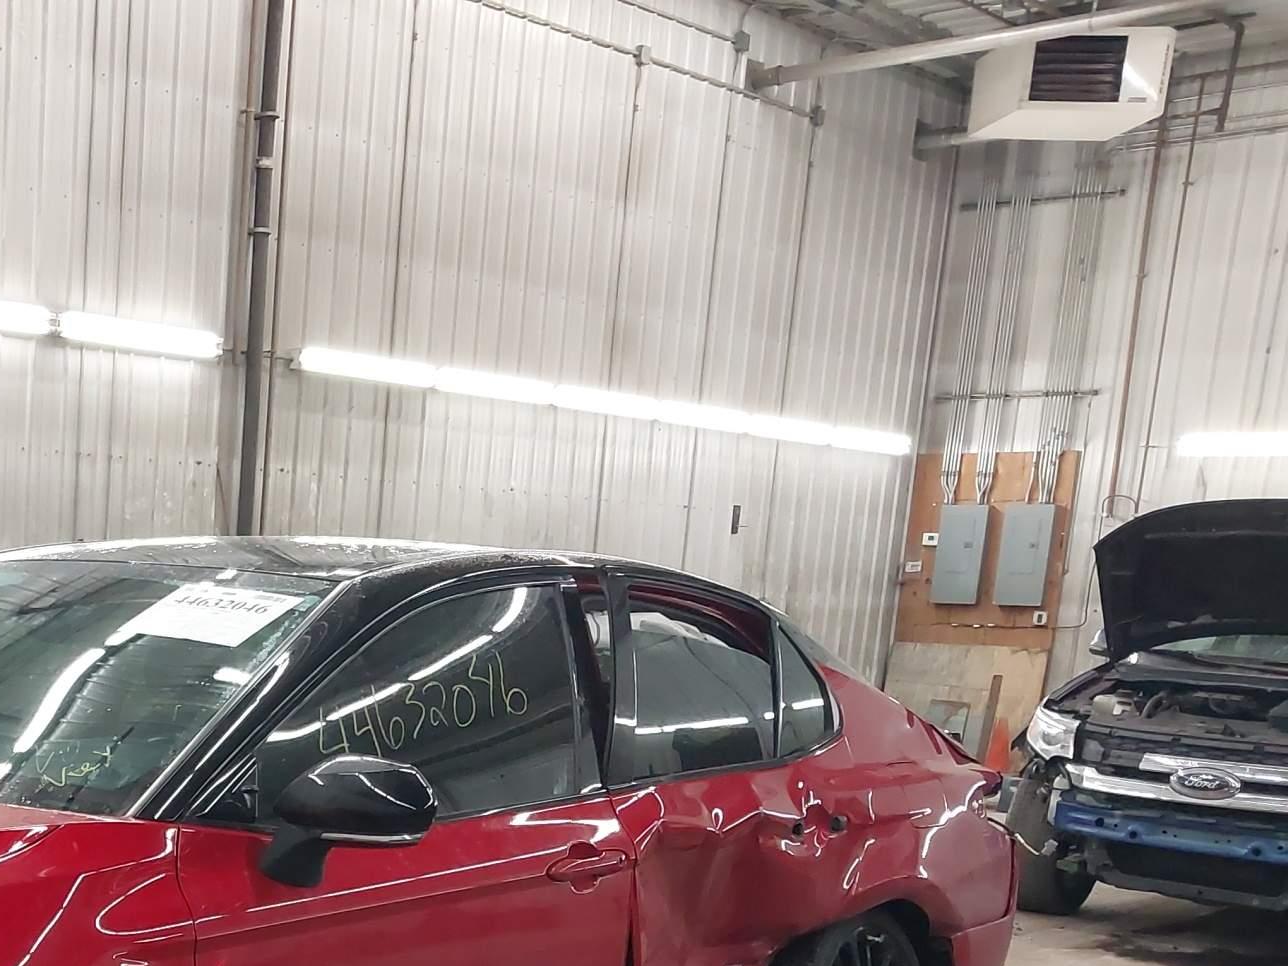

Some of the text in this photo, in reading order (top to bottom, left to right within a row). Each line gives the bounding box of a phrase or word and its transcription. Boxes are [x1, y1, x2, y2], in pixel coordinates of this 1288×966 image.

[175, 595, 268, 614] 44632046
[319, 651, 528, 757] 44632046
[1183, 774, 1220, 789] Ford
